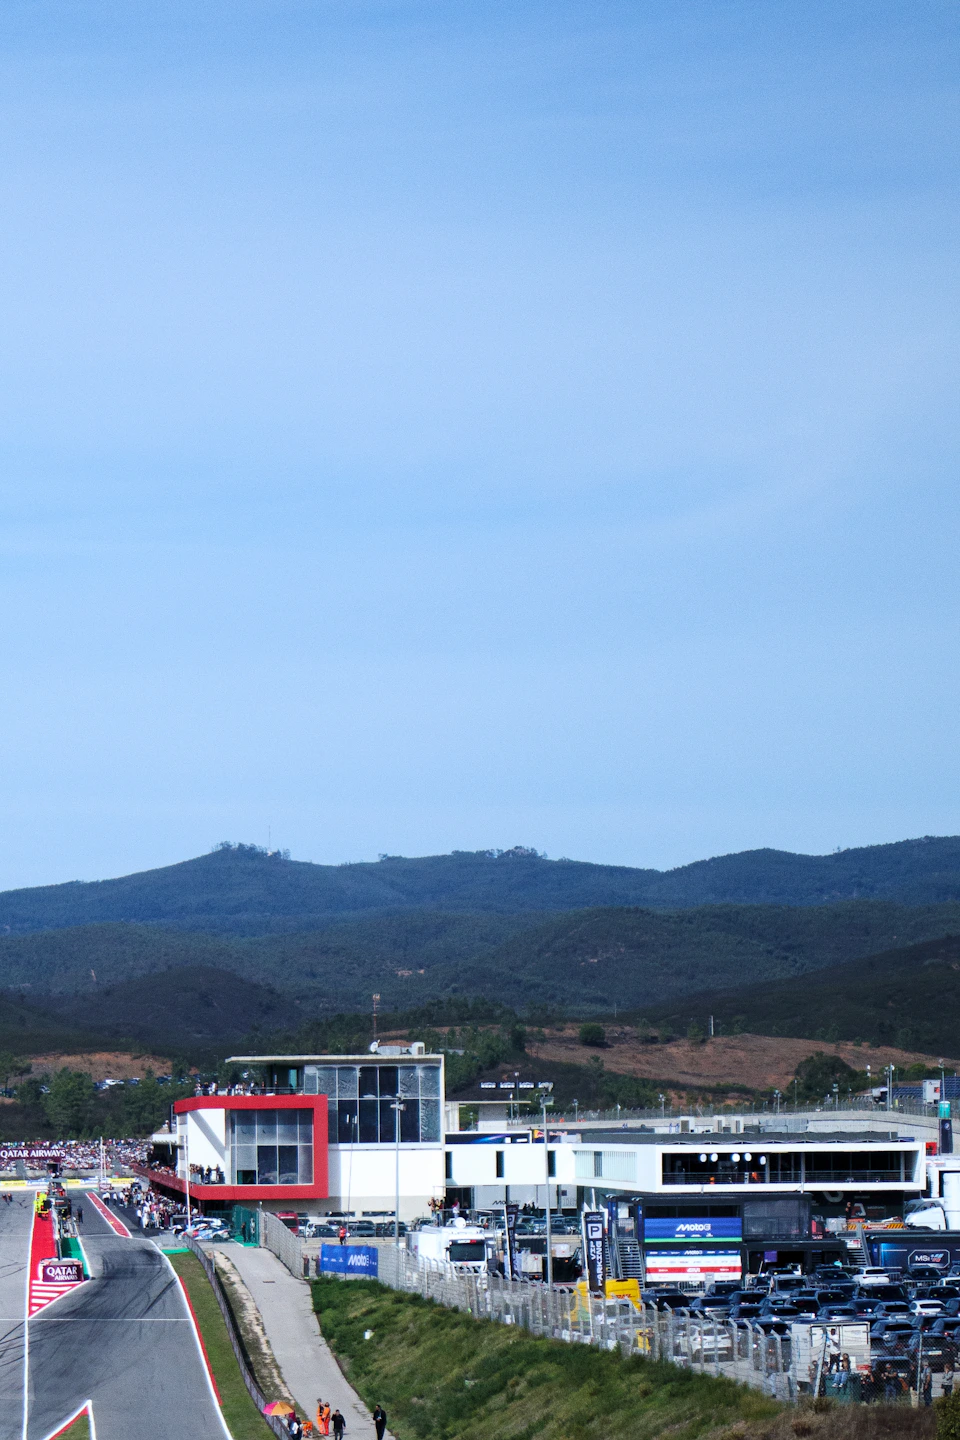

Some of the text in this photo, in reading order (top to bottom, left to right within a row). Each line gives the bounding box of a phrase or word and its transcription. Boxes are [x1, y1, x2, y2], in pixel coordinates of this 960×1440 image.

[0, 1150, 29, 1158] QATAR
[30, 1149, 66, 1158] AIRWAYS
[590, 1226, 600, 1236] P
[46, 1267, 78, 1276] QATAR
